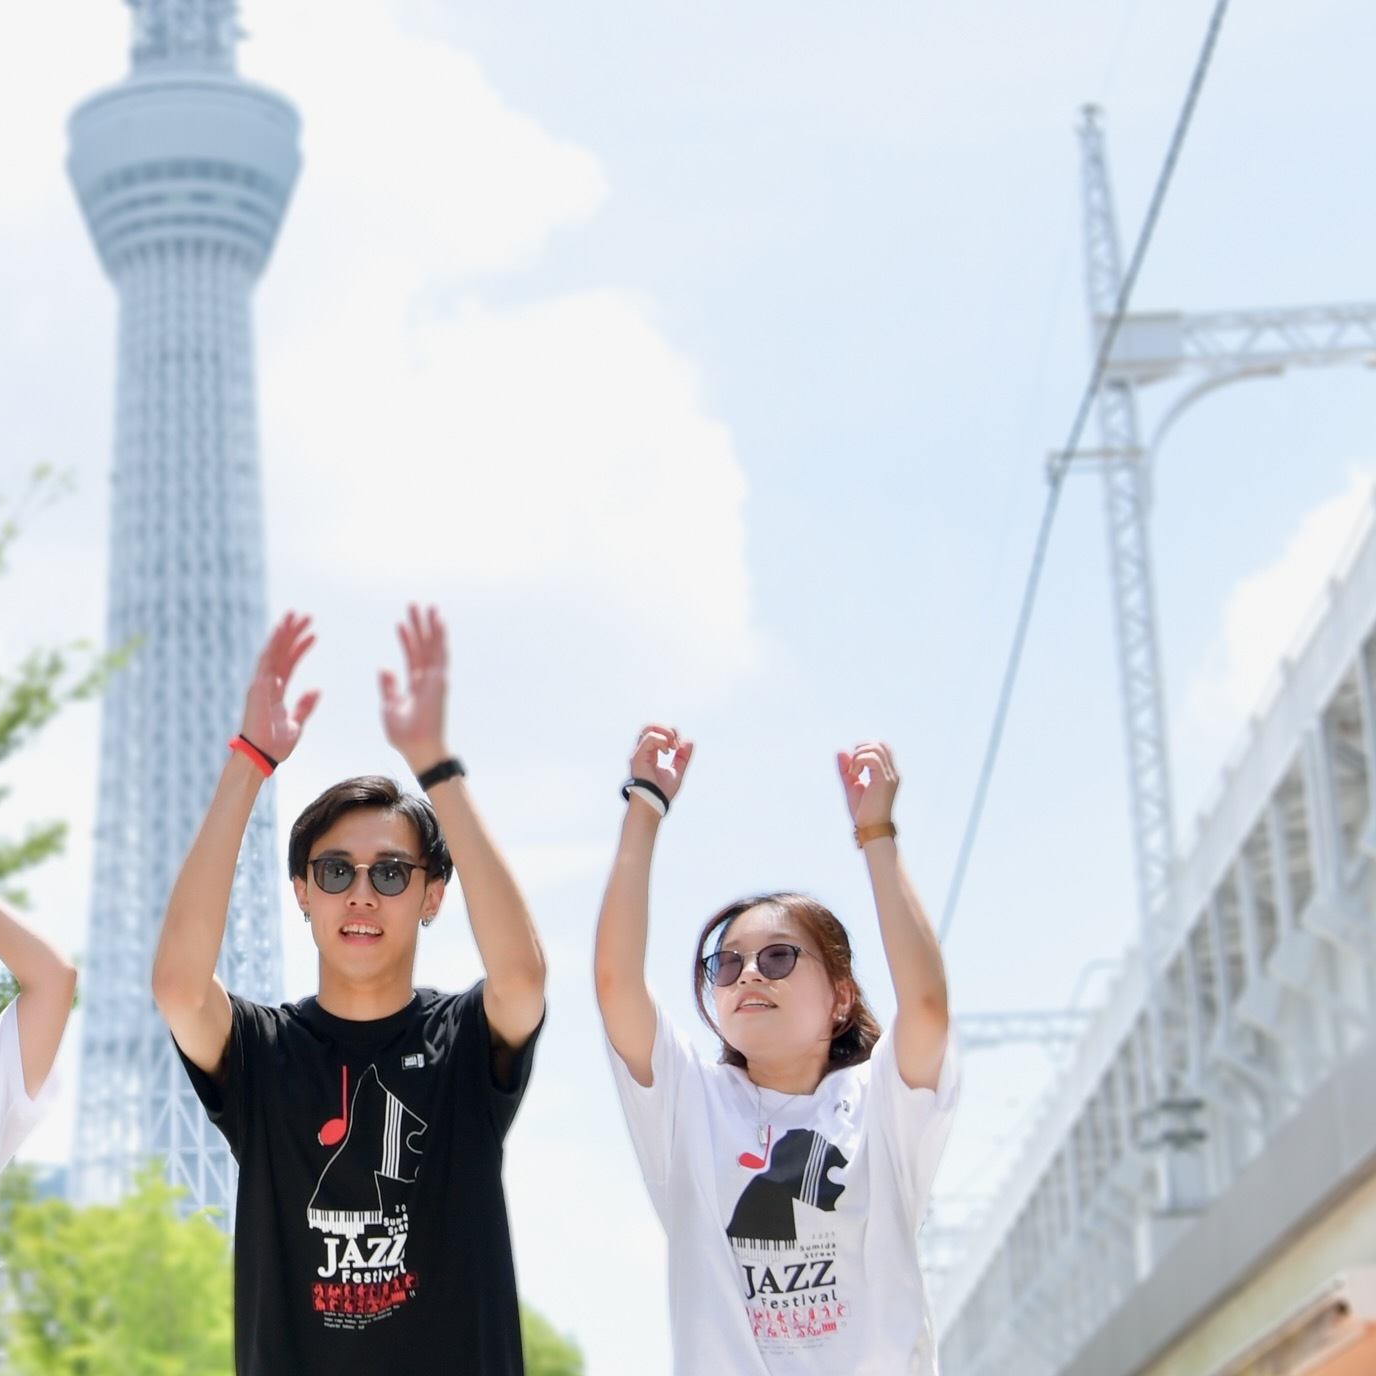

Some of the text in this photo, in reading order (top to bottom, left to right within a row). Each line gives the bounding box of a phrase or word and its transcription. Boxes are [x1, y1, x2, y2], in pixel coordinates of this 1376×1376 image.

[317, 1232, 407, 1278] JAZZ
[800, 1242, 836, 1252] Sumida
[804, 1251, 836, 1259] Street
[742, 1259, 836, 1300] JAZZ
[761, 1289, 837, 1309] Festival
